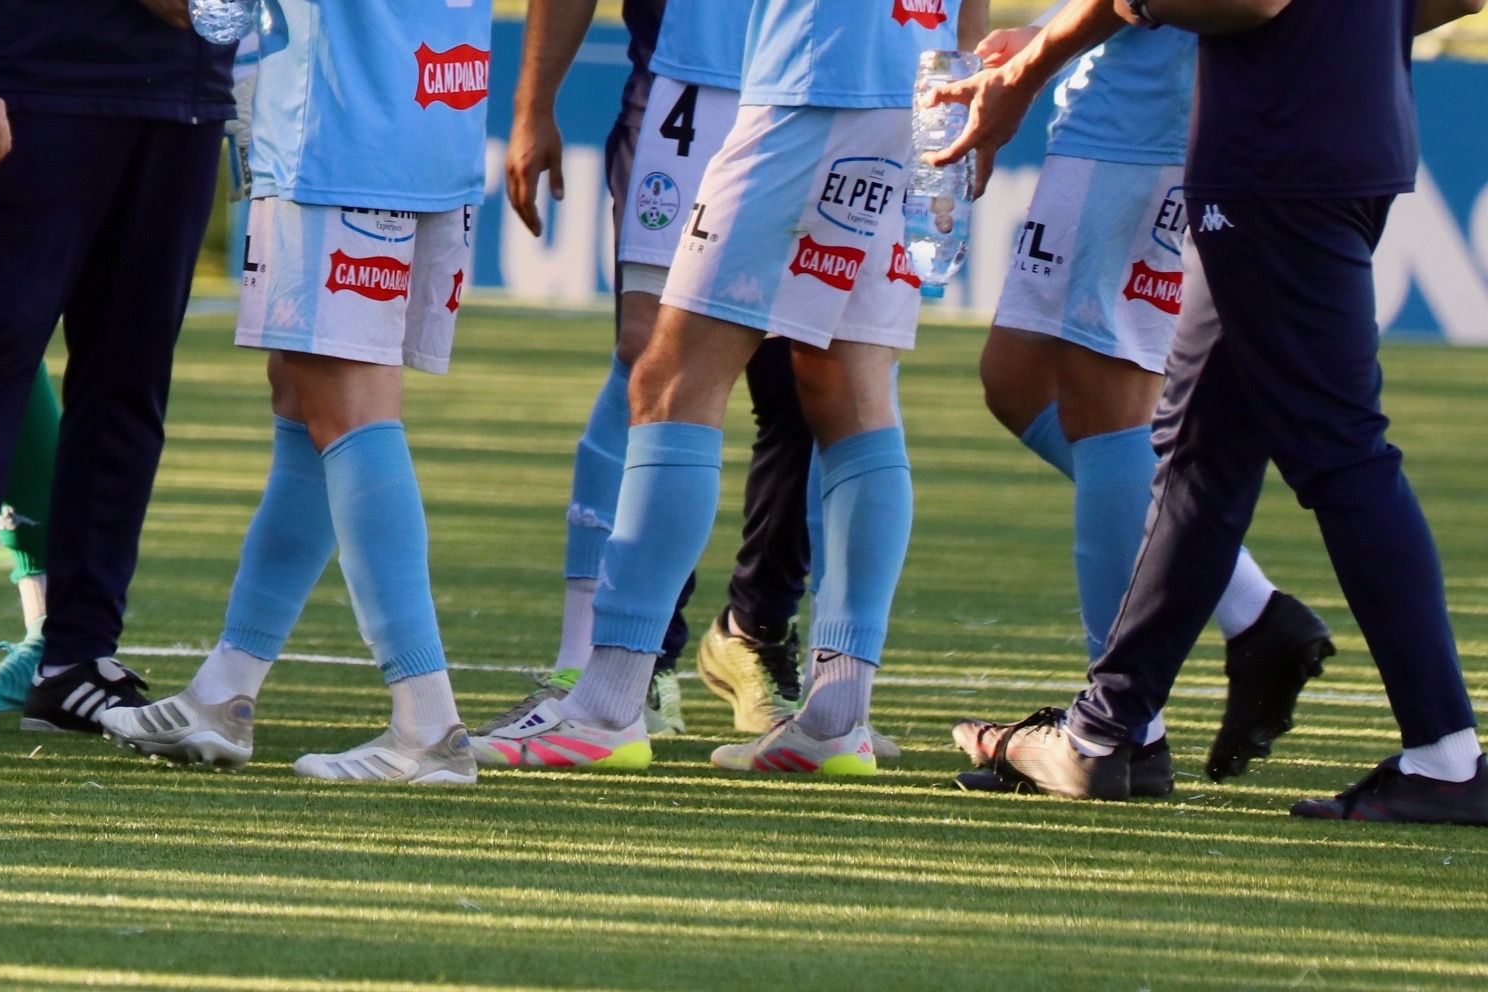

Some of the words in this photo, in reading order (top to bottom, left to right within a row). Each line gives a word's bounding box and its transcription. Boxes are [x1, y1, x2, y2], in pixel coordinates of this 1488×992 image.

[660, 85, 699, 157] 4
[821, 172, 848, 204] EL
[1154, 198, 1183, 231] EL
